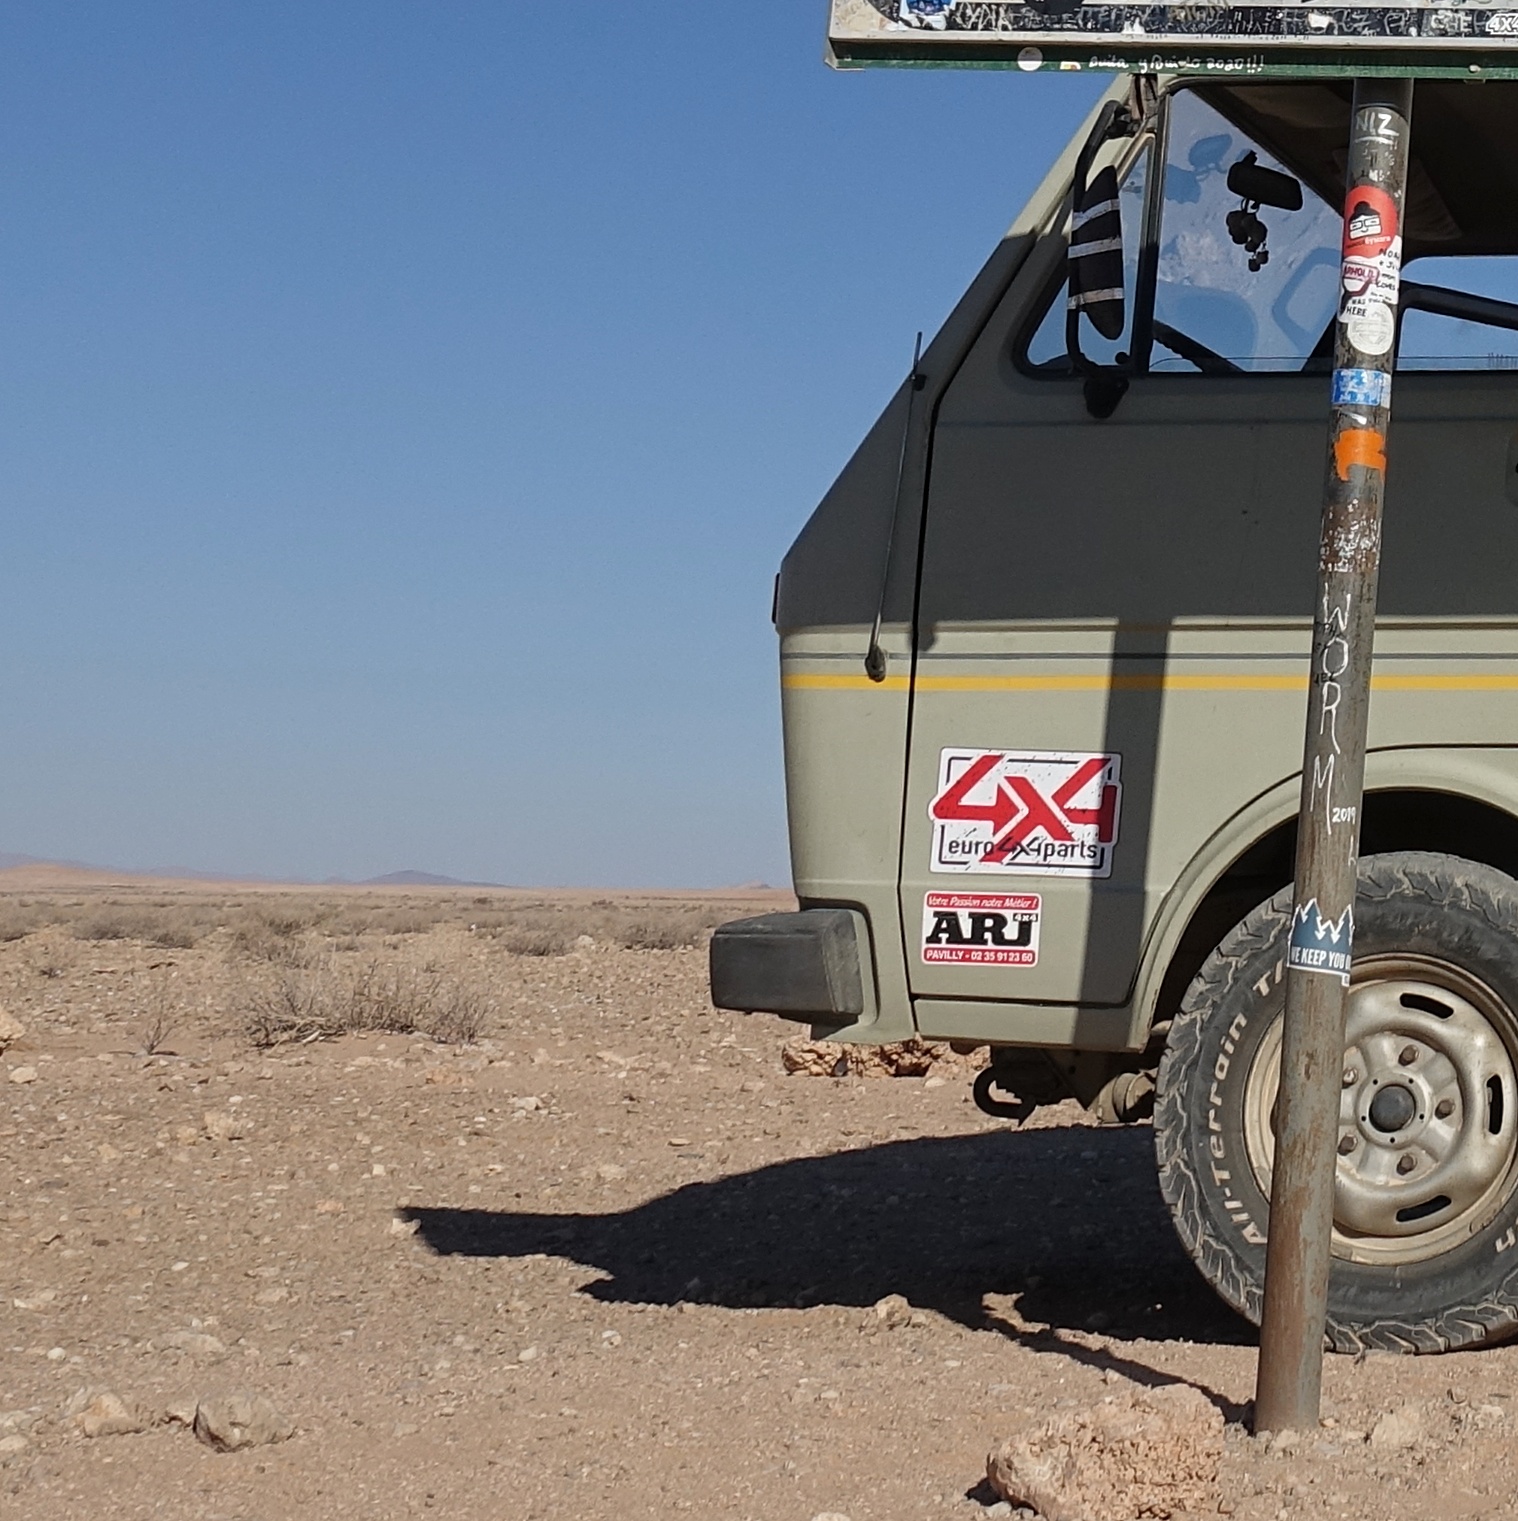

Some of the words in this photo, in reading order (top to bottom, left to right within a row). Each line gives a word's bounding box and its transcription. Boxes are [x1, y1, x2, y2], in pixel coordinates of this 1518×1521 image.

[933, 754, 1118, 864] 4X4
[1332, 806, 1357, 824] 2019
[948, 836, 1098, 862] euro4x4parts
[928, 895, 949, 907] Votre
[949, 895, 980, 907] Passion
[980, 897, 1002, 908] notre
[925, 910, 1033, 947] ARJ
[926, 948, 964, 960] PAVILLY
[970, 951, 983, 961] 02
[983, 951, 996, 961] 35
[1301, 946, 1327, 966] KEEP
